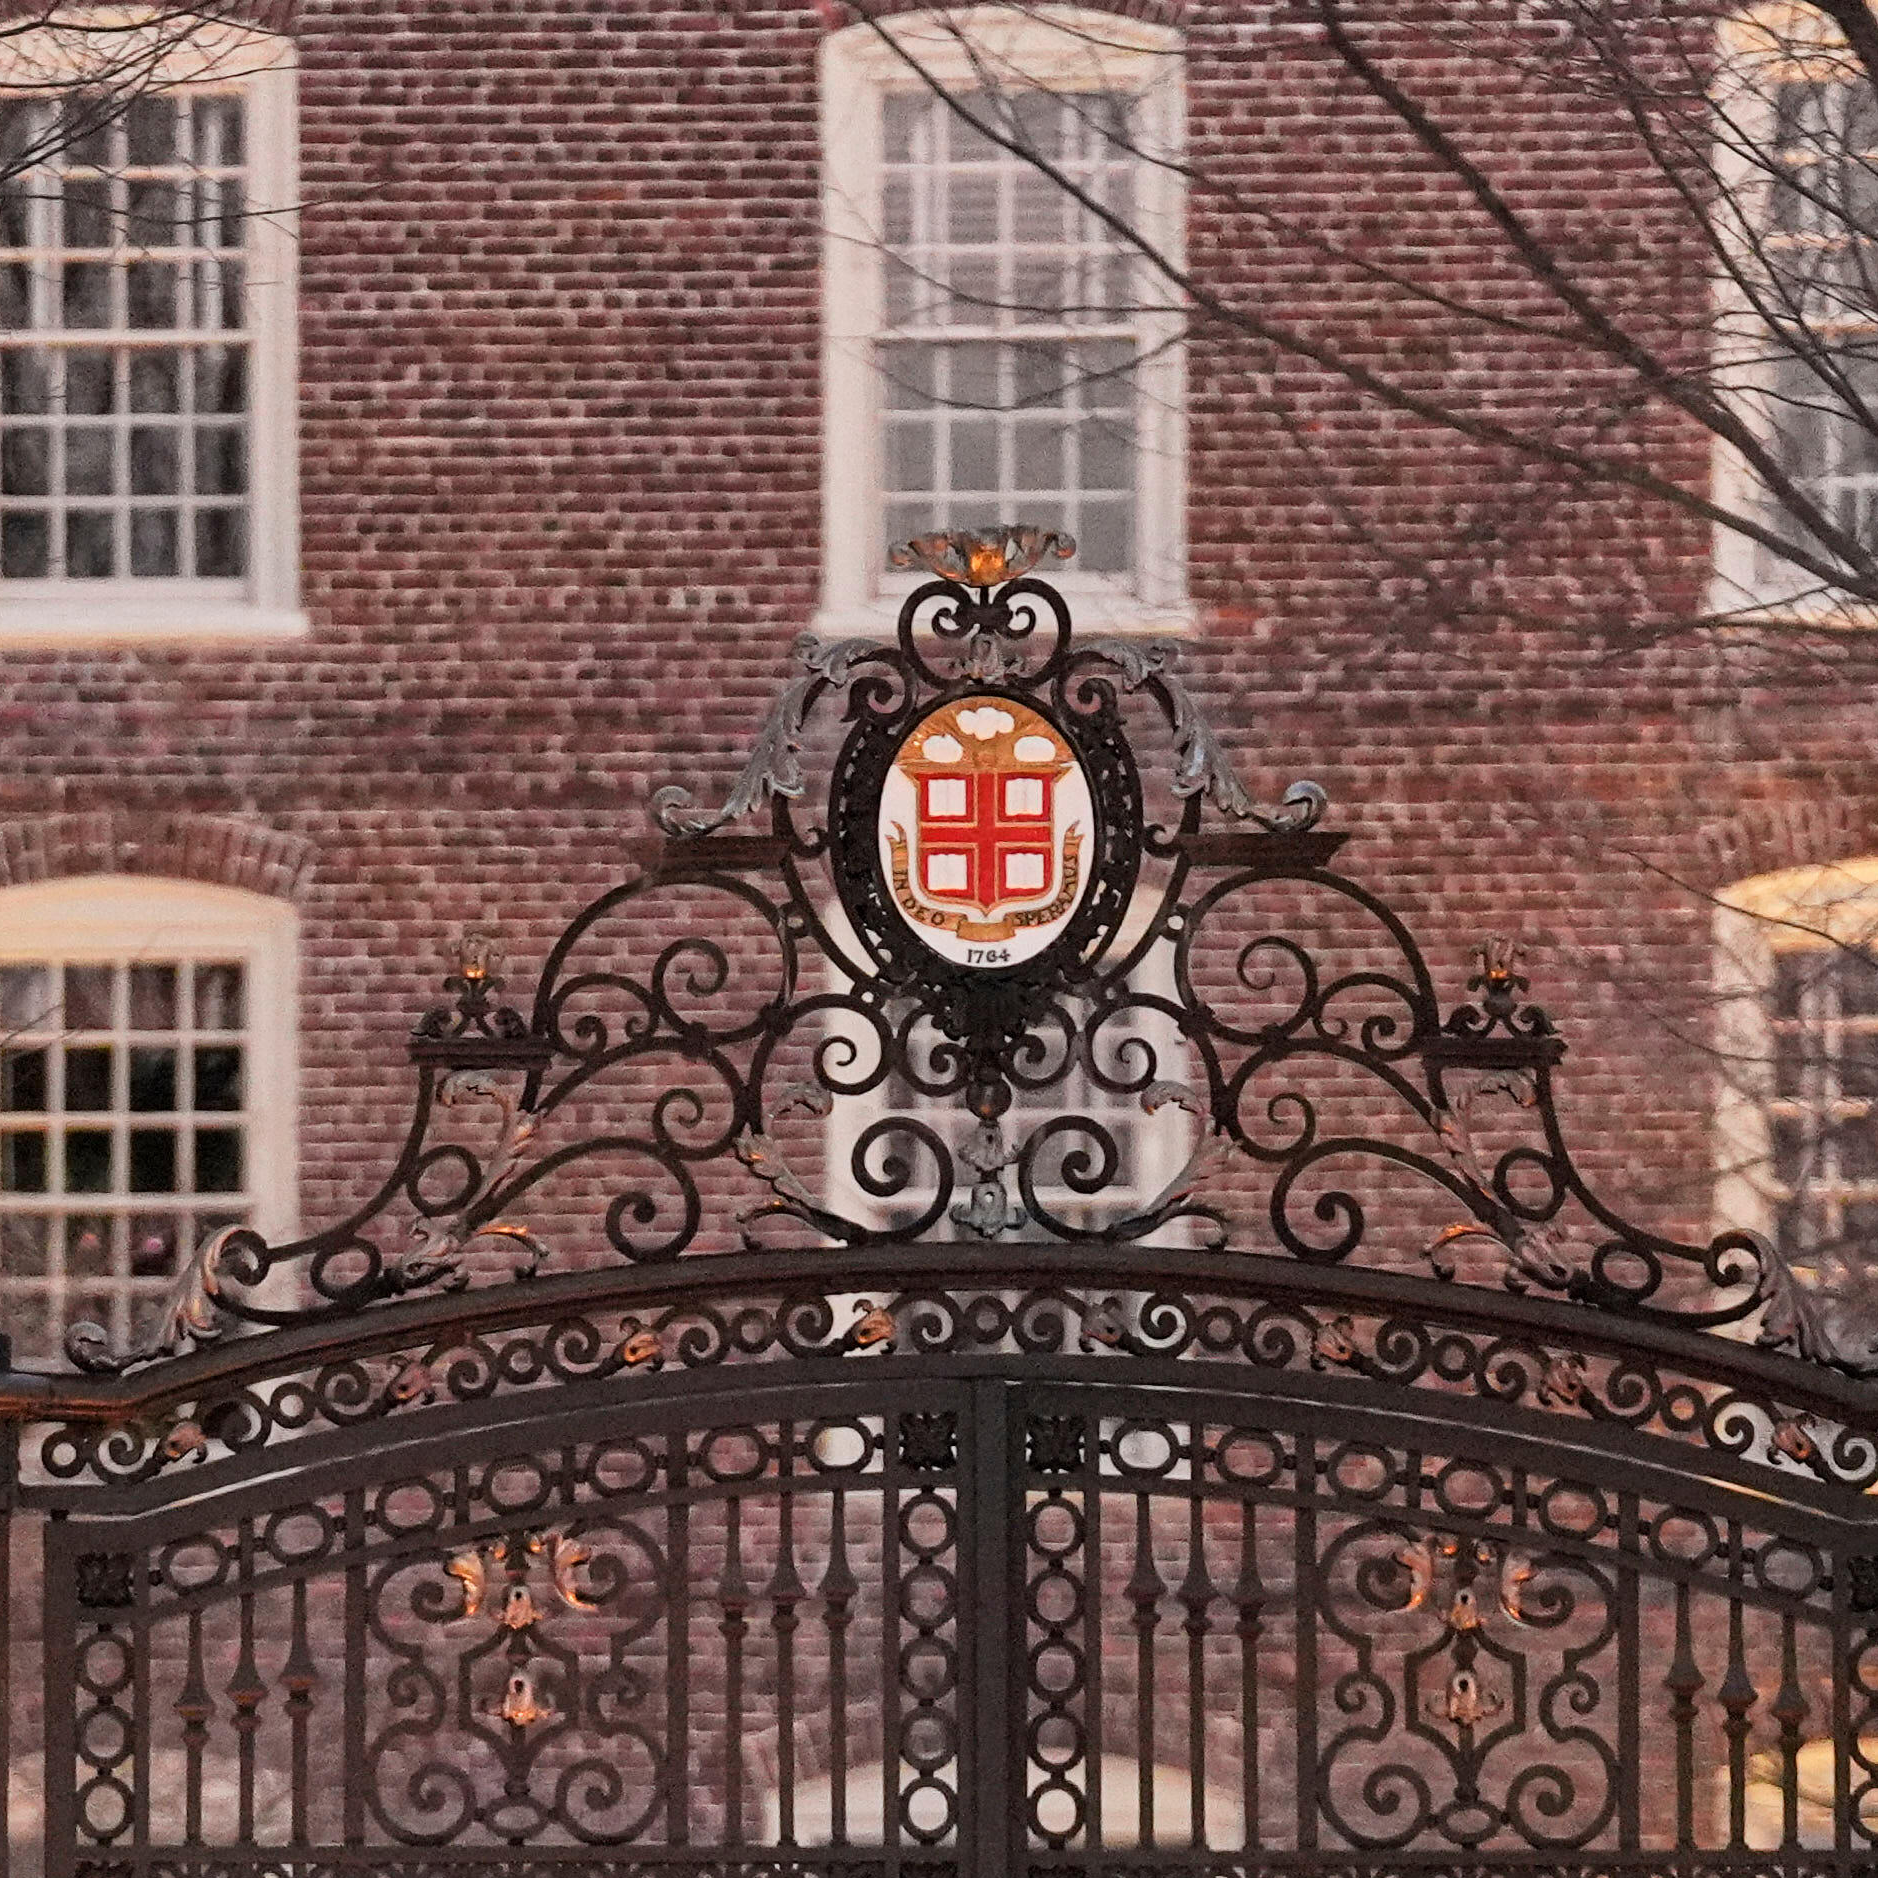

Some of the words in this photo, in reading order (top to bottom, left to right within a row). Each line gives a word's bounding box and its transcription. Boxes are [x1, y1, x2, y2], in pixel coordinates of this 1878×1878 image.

[893, 870, 909, 890] IN
[904, 898, 945, 926] DEO
[967, 949, 1011, 964] 1764
